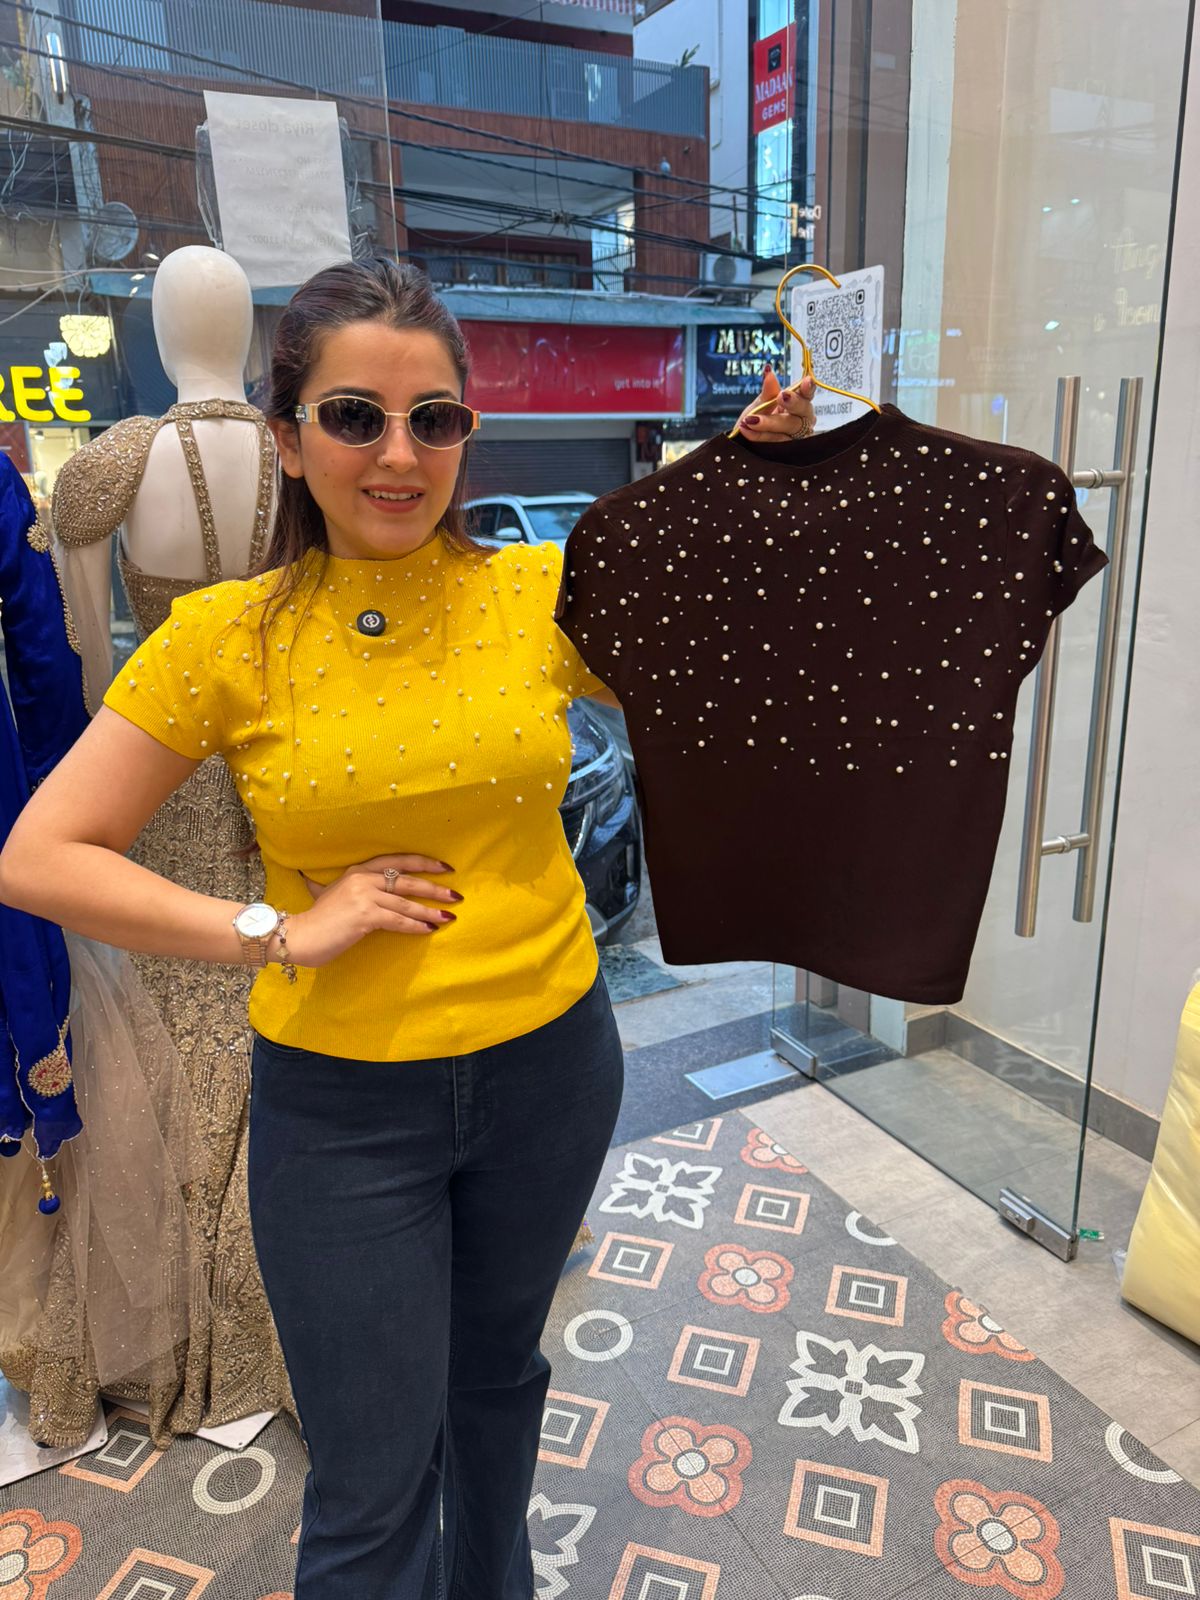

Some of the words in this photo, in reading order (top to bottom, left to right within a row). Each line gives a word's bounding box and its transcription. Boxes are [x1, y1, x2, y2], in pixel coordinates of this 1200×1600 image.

[761, 98, 786, 121] GEMS
[632, 377, 652, 389] into
[712, 382, 741, 395] Silver
